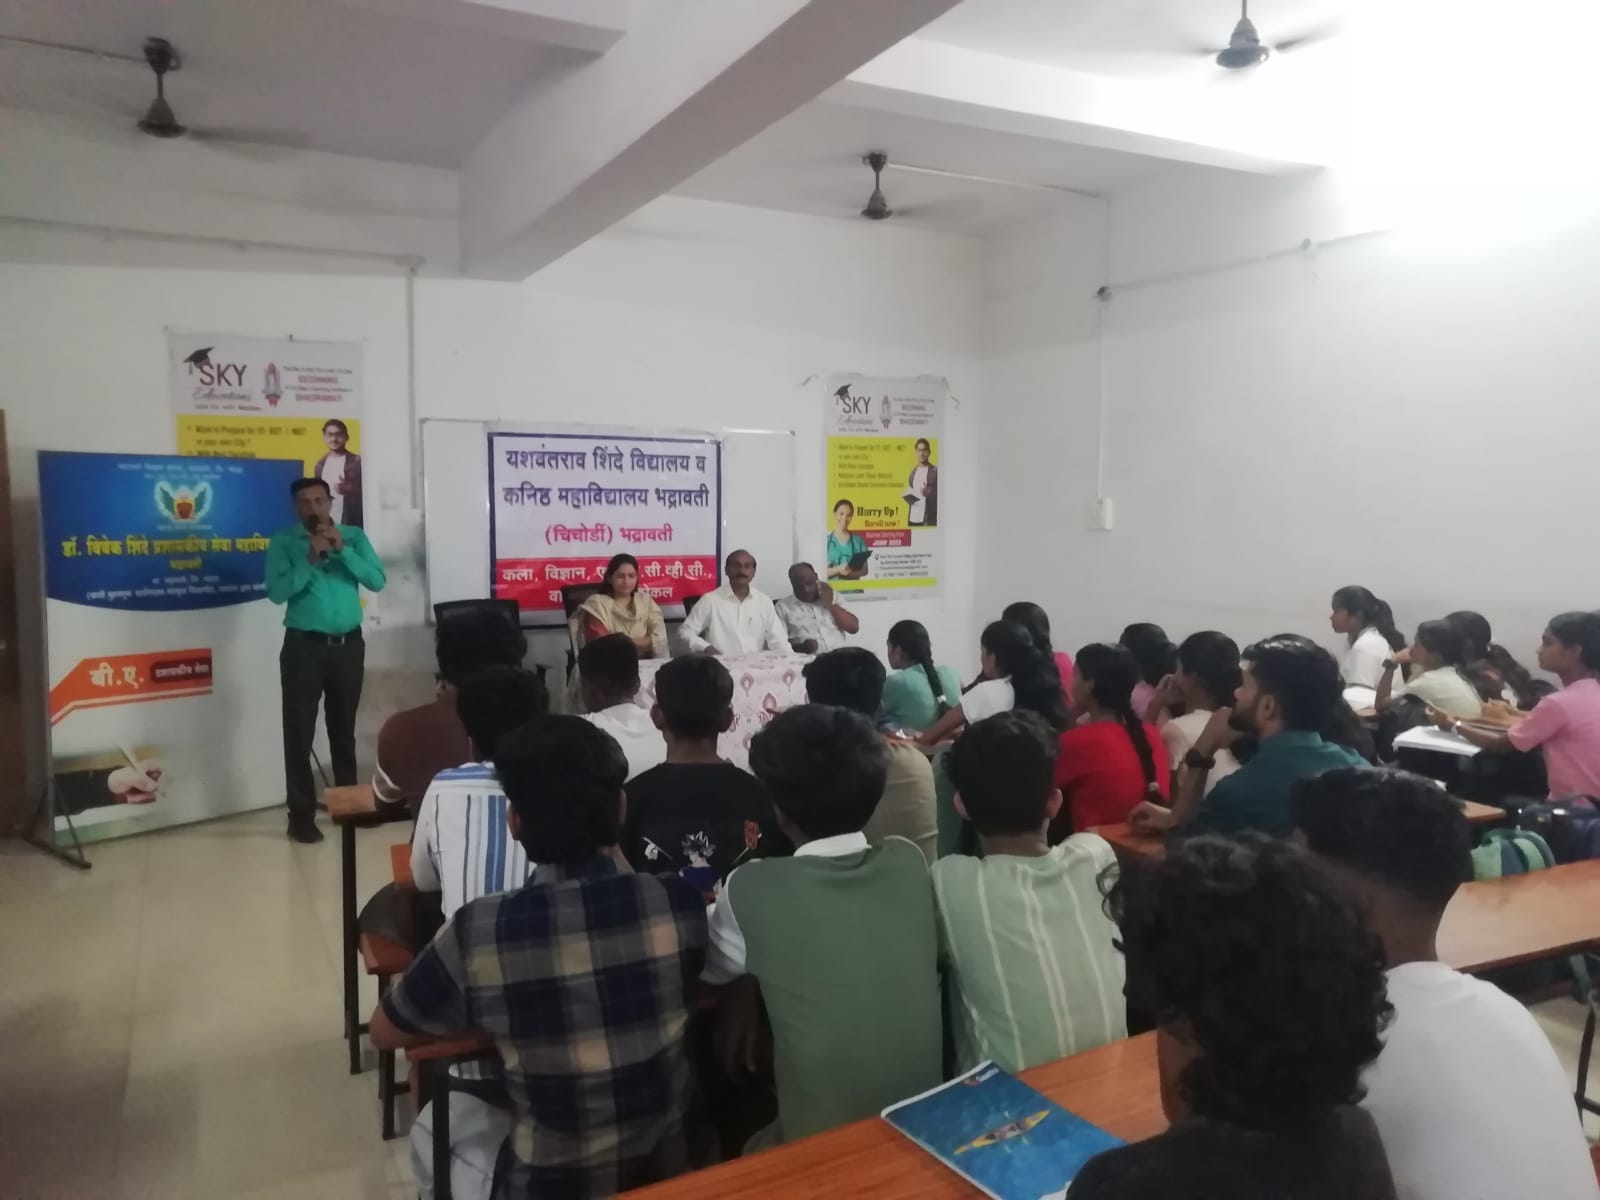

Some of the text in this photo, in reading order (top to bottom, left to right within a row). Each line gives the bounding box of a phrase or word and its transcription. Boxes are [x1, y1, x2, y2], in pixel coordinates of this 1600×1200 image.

[200, 362, 247, 387] SKY
[842, 396, 871, 415] SKY
[506, 443, 706, 473] यशवंतराव शिंदे विद्यालय व
[502, 481, 709, 509] कनिष्ठ महाविद्यालय भद्रावती
[620, 523, 672, 543] भद्रावती
[502, 568, 538, 582] कला,
[545, 564, 590, 581] विज्ञान,
